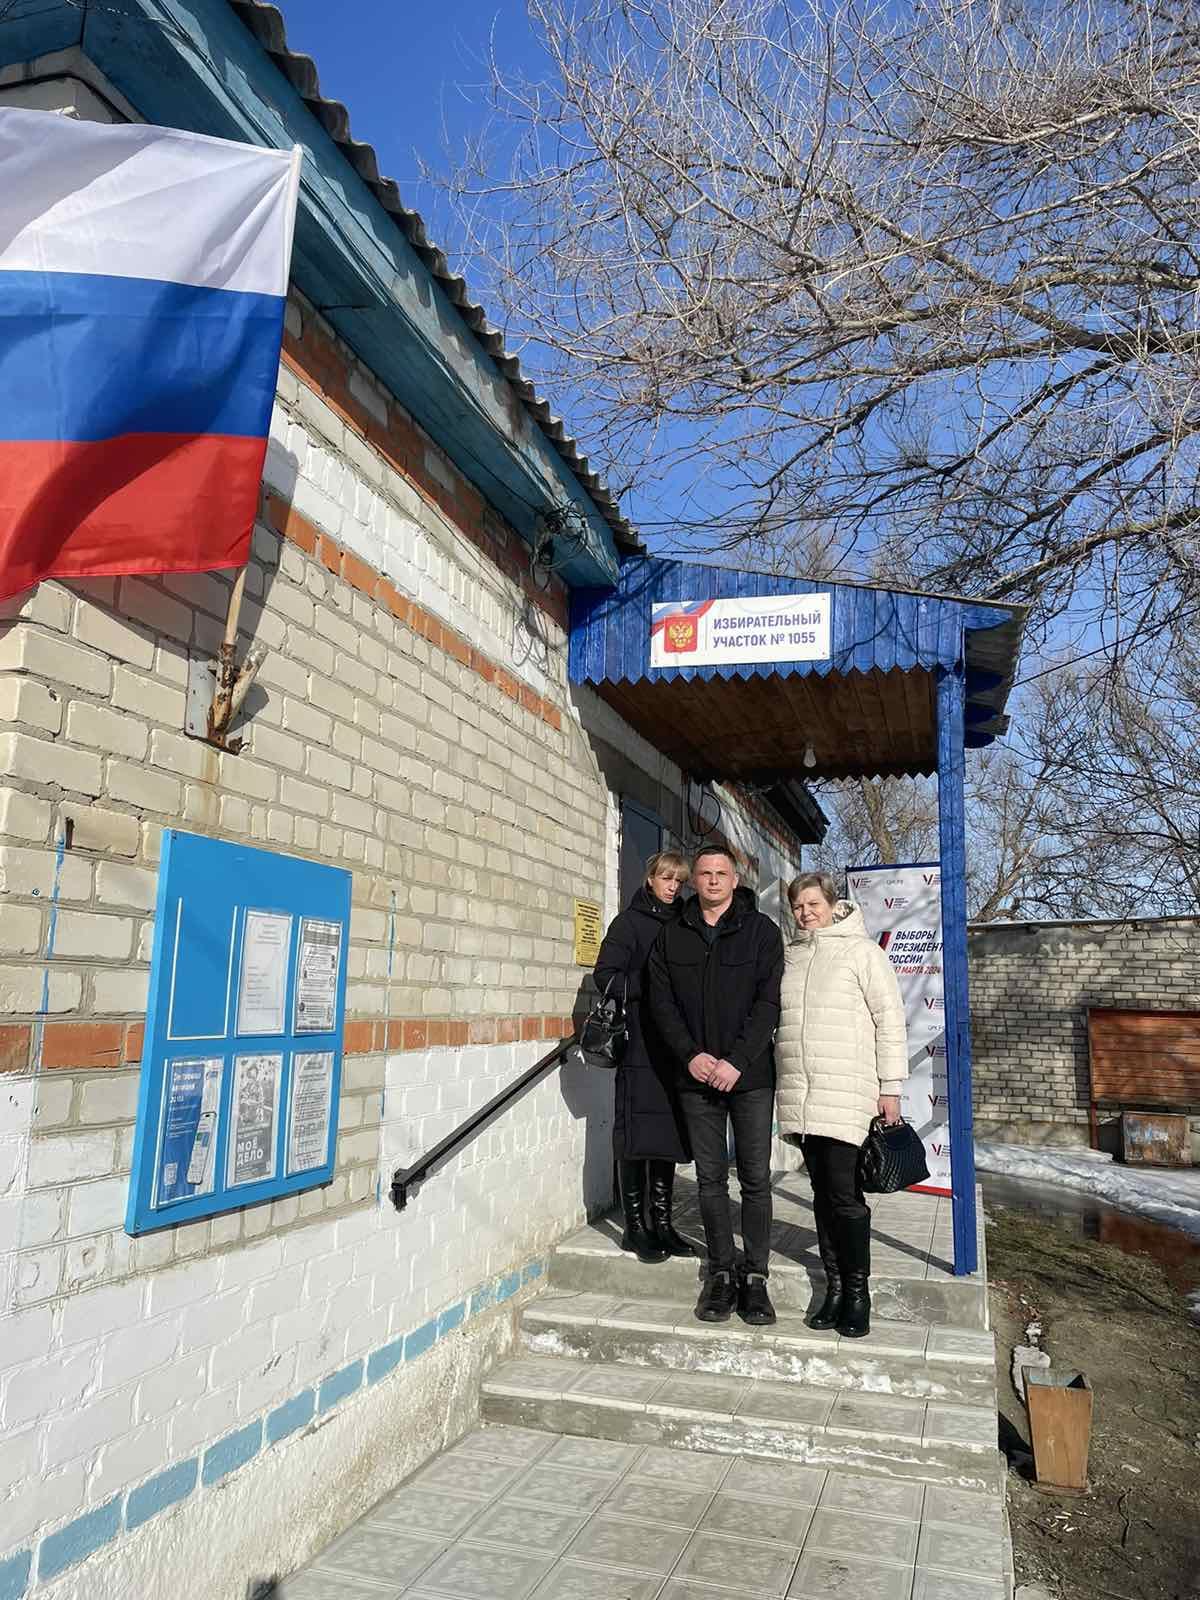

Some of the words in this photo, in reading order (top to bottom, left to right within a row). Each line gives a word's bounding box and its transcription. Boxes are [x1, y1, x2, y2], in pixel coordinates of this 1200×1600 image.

[713, 610, 821, 629] ИЗБИРАТЕЛЬНЫЙ
[713, 635, 767, 648] УЧАСТОК
[770, 633, 785, 645] №
[788, 632, 816, 645] 1055
[896, 931, 936, 940] ВЫБОРЫ
[891, 943, 944, 952] ПРЕЗИДЕНТ
[902, 966, 923, 974] МАРТА
[236, 1148, 263, 1166] ДЕЛО
